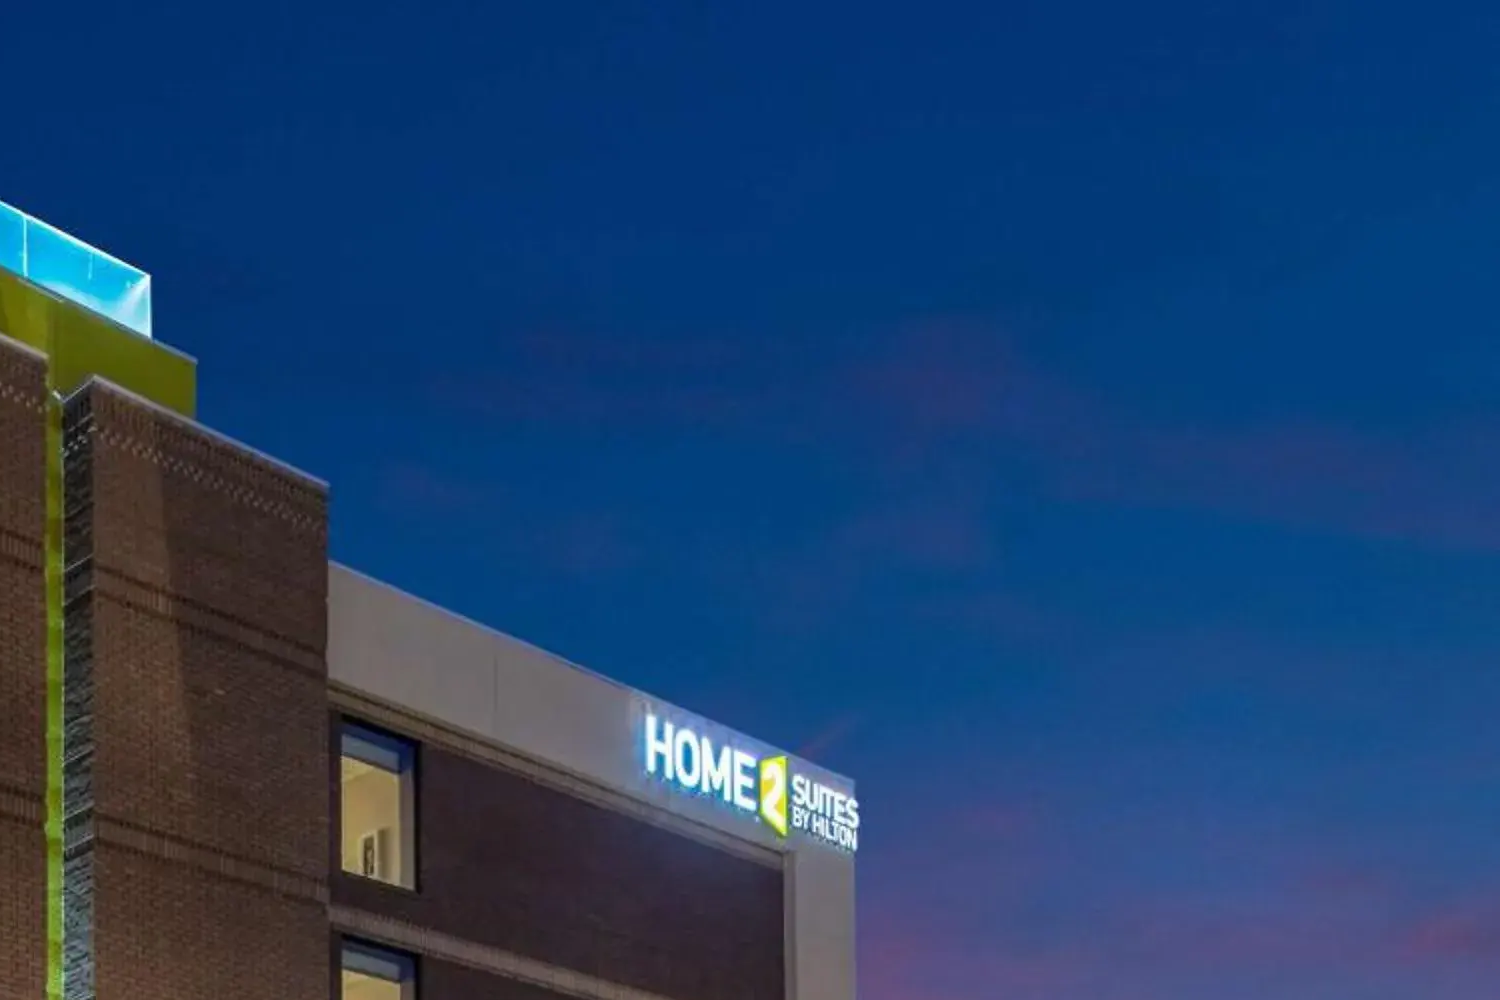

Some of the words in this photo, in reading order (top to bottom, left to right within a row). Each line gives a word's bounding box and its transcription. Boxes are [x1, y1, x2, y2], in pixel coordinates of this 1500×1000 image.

[645, 713, 757, 812] HOME
[761, 761, 787, 837] 2
[792, 773, 859, 829] SUITES
[792, 806, 810, 829] BY
[812, 814, 858, 851] HILTON
